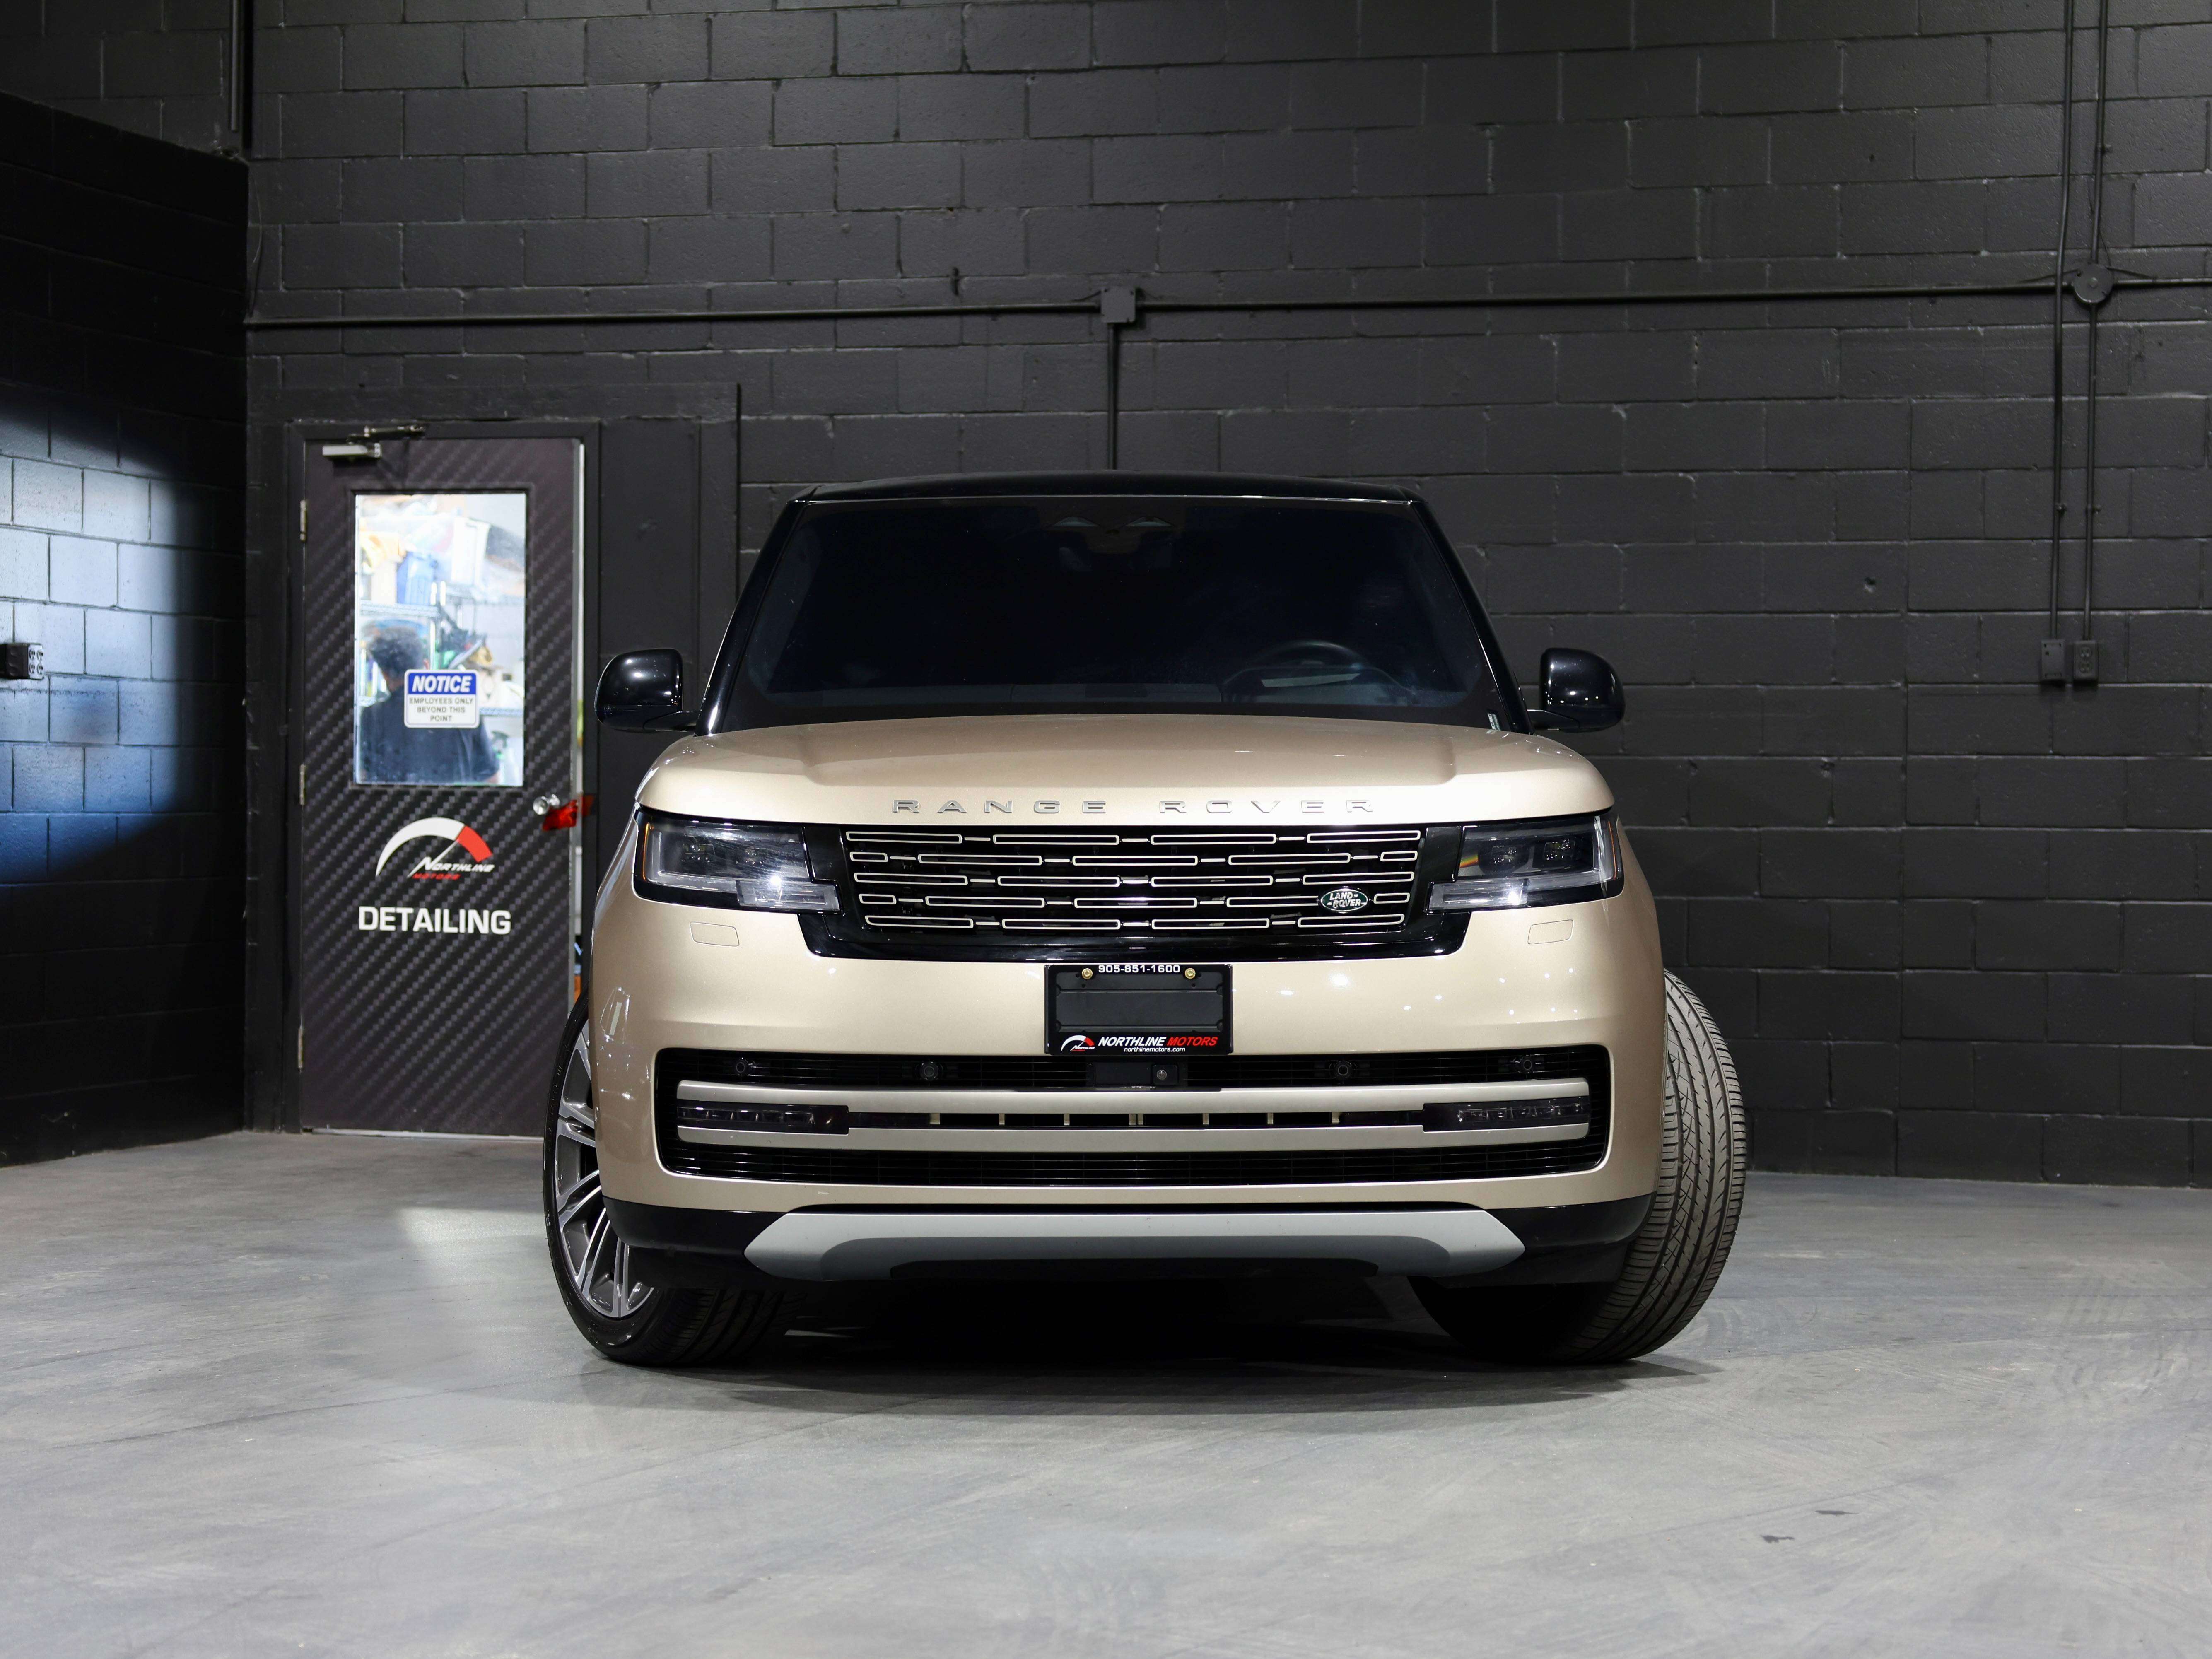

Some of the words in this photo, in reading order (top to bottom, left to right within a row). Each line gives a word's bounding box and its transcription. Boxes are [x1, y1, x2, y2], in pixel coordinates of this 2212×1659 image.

[412, 675, 473, 693] NOTICE
[892, 800, 1107, 813] RANGE
[1159, 800, 1374, 813] ROVER
[1329, 892, 1353, 900] LAND
[1332, 899, 1362, 907] ROVER
[358, 906, 511, 935] DETAILING
[1098, 965, 1181, 973] 905-851-1600
[1098, 1037, 1167, 1046] NORTHLINE
[1166, 1037, 1218, 1047] MOTORS
